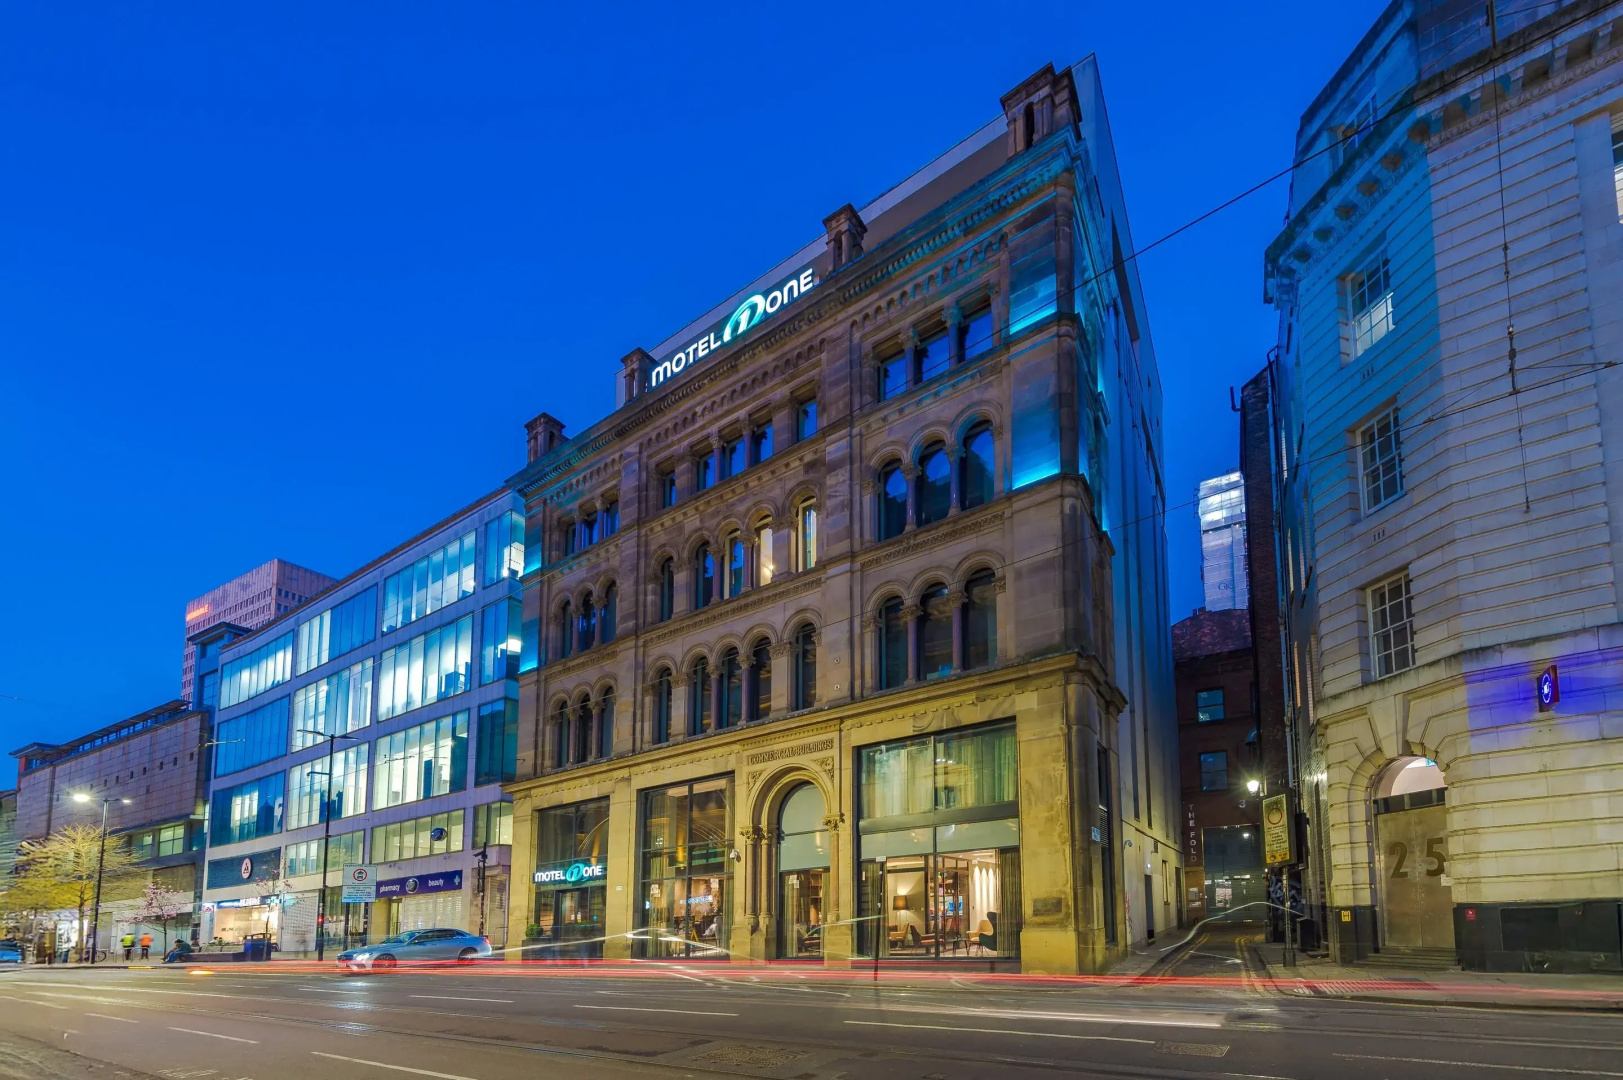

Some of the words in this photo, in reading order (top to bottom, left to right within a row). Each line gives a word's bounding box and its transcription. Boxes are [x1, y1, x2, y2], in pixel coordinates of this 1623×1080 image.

[652, 332, 722, 387] MOTEL
[765, 268, 814, 314] ONE
[750, 748, 794, 764] COMMERCIAL
[795, 739, 833, 755] BUILDINGS
[1238, 799, 1246, 808] 3
[1388, 837, 1446, 878] 25
[535, 870, 566, 882] MOTEL
[583, 865, 603, 877] ONE
[379, 884, 401, 894] pharmacy
[428, 878, 445, 887] beauty
